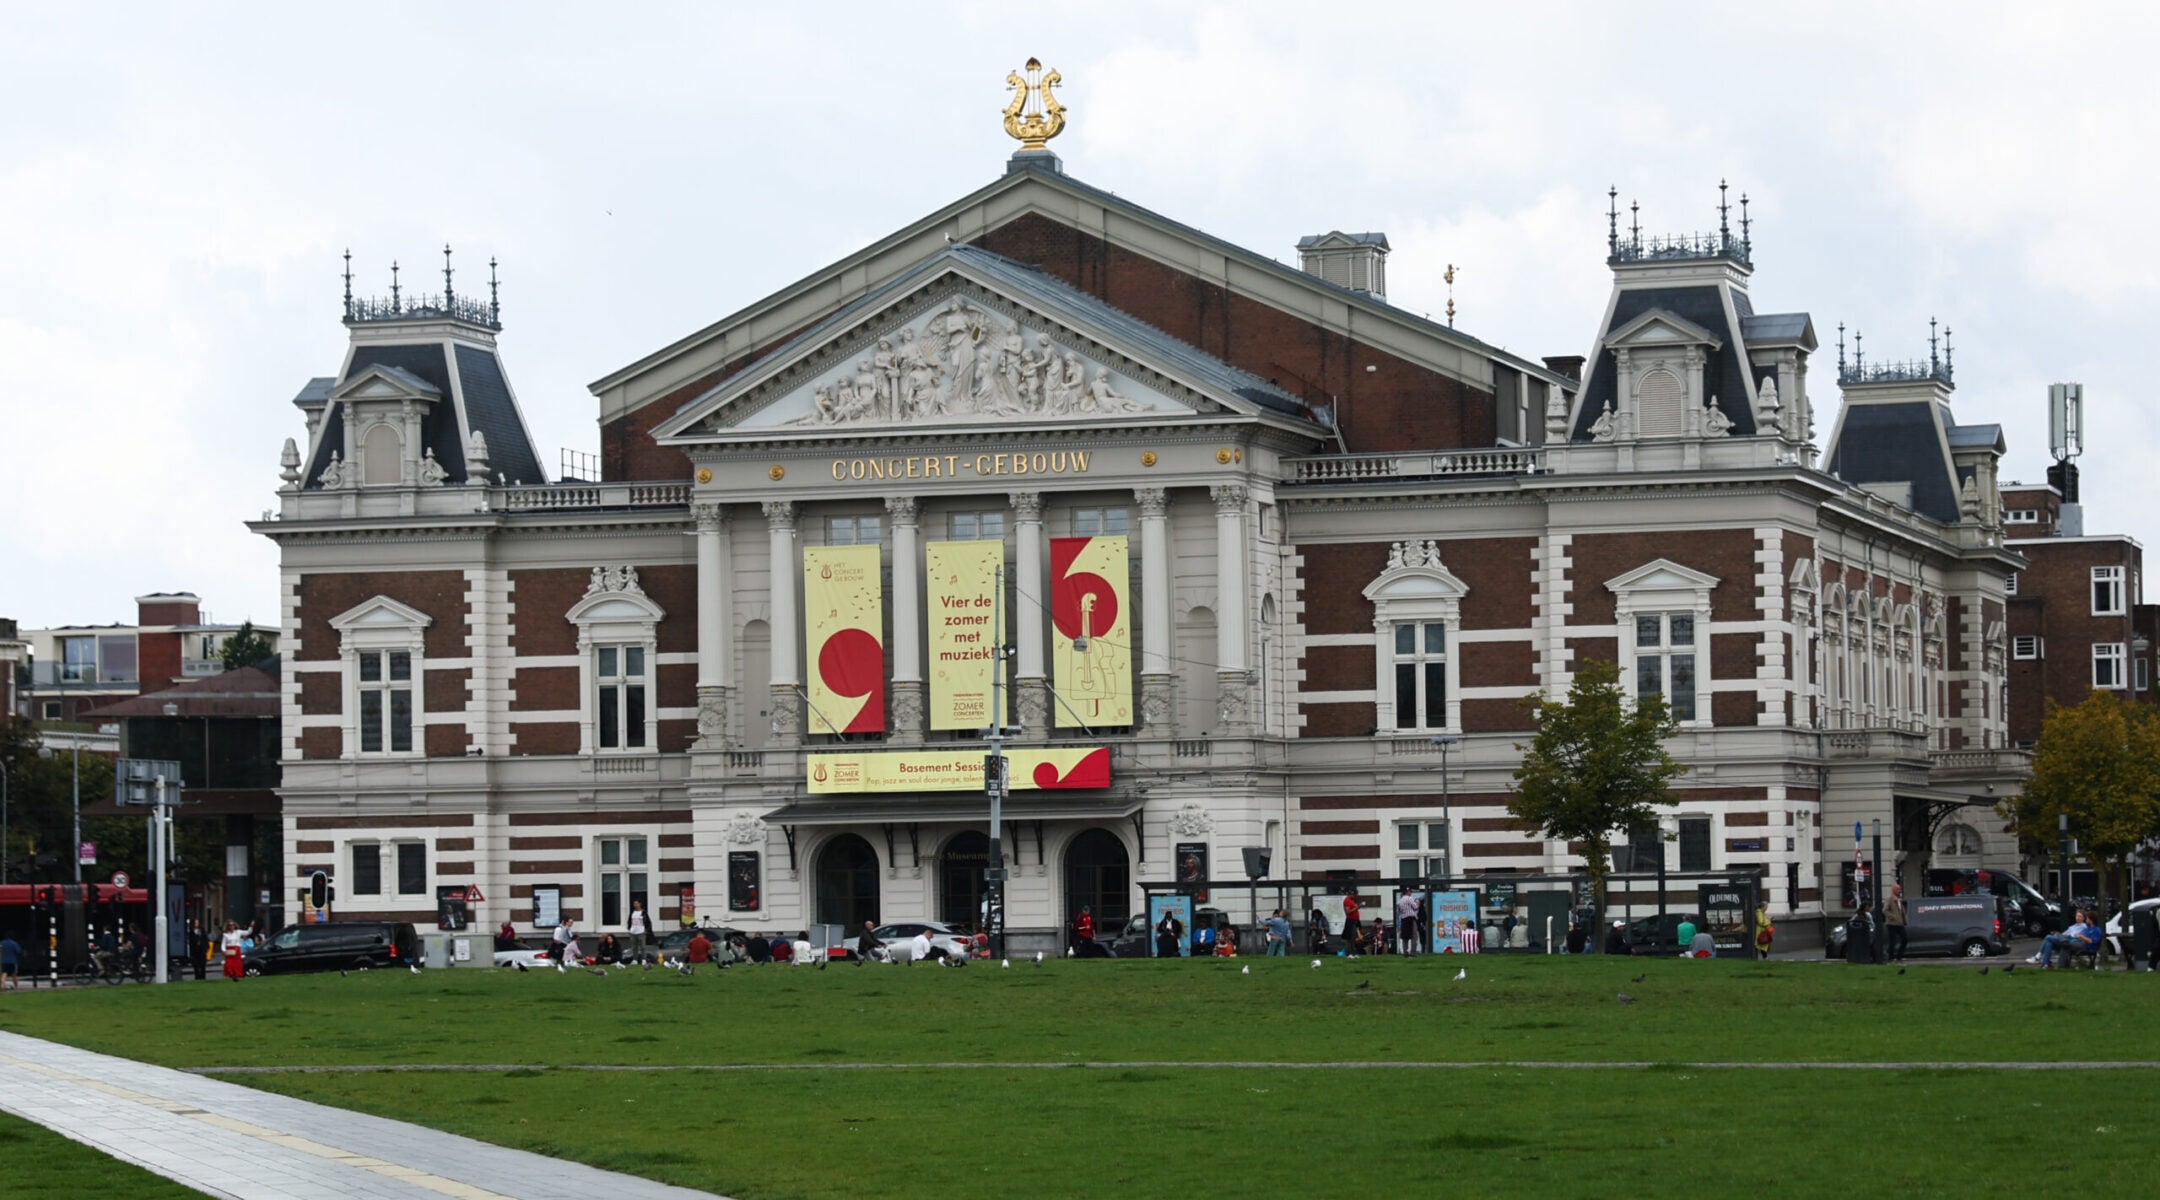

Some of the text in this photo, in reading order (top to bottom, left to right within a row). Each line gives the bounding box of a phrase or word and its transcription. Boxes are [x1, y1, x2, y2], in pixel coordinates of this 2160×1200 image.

[832, 452, 1091, 481] CONCERT-GEBOUW
[941, 593, 991, 608] Vier de
[945, 616, 989, 626] zomer
[954, 631, 981, 643] met
[953, 702, 984, 710] ZOMER
[899, 762, 952, 773] Basement
